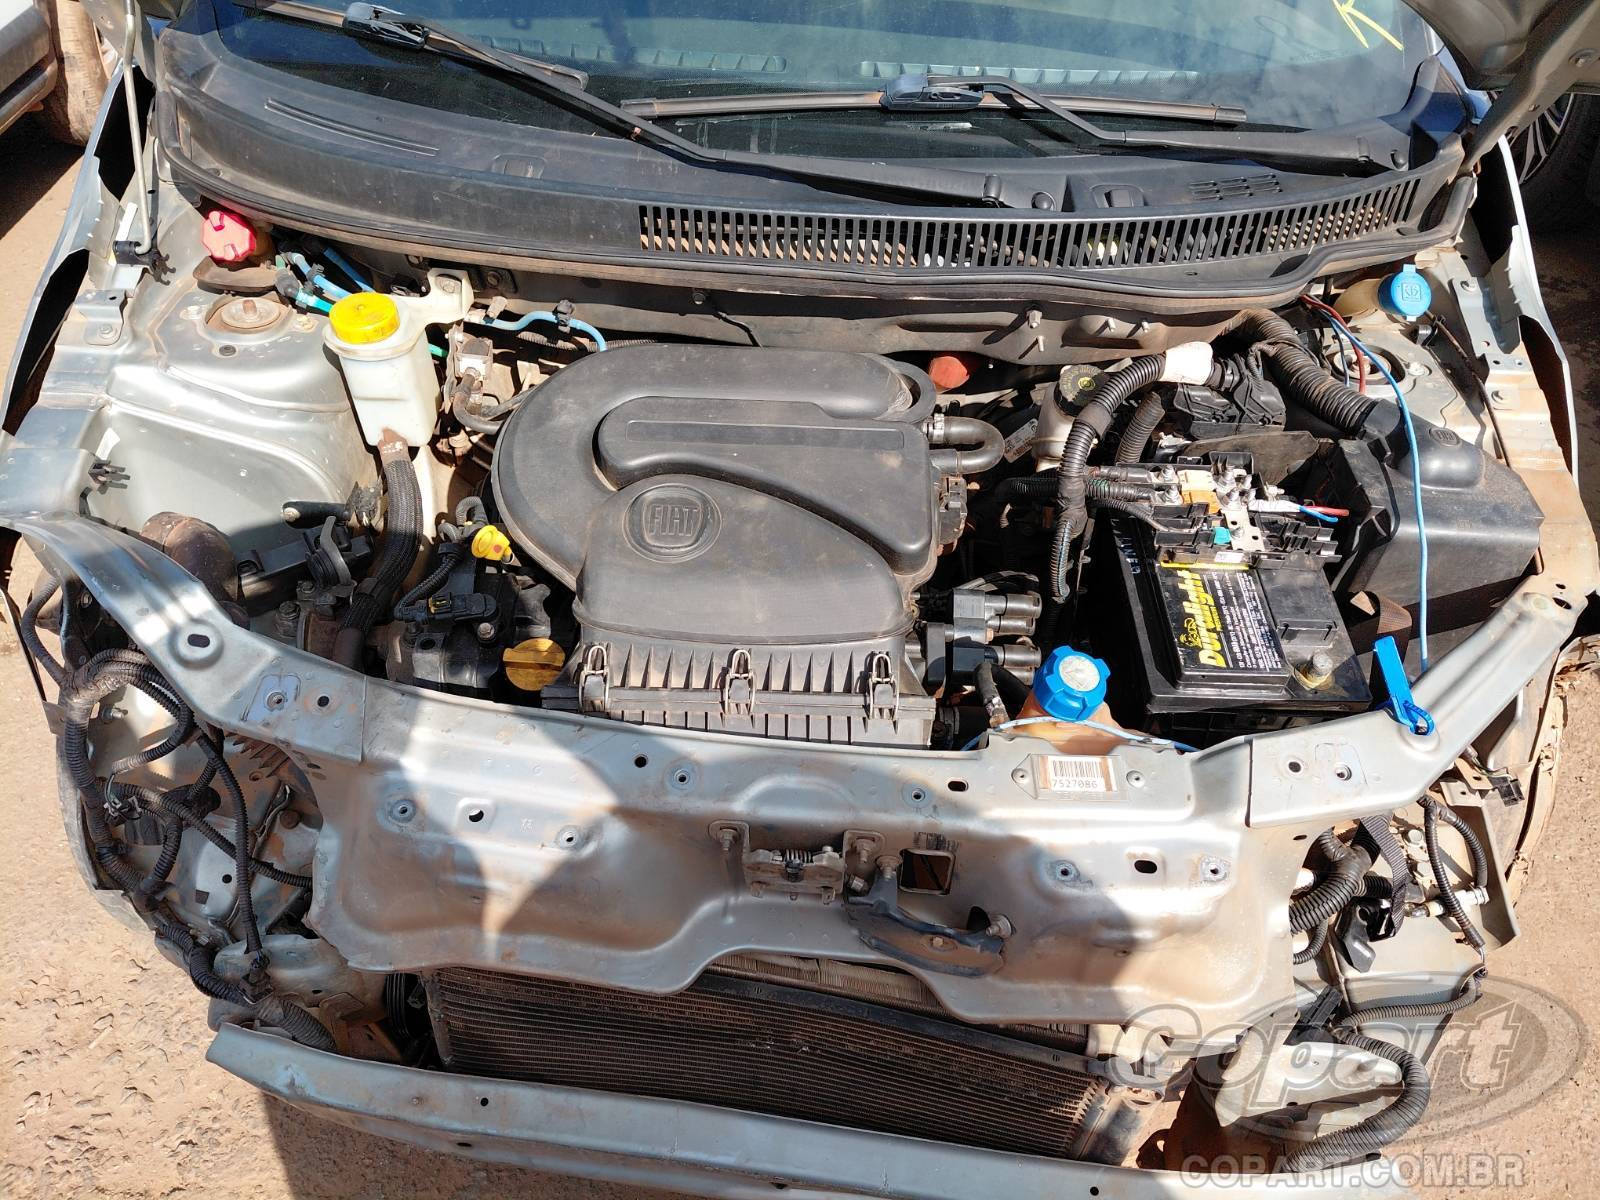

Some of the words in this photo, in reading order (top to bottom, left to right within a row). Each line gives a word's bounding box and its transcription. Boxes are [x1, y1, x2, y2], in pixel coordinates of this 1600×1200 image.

[648, 504, 701, 537] FIAT
[1177, 568, 1226, 668] Duralight
[1051, 778, 1098, 789] 7527086
